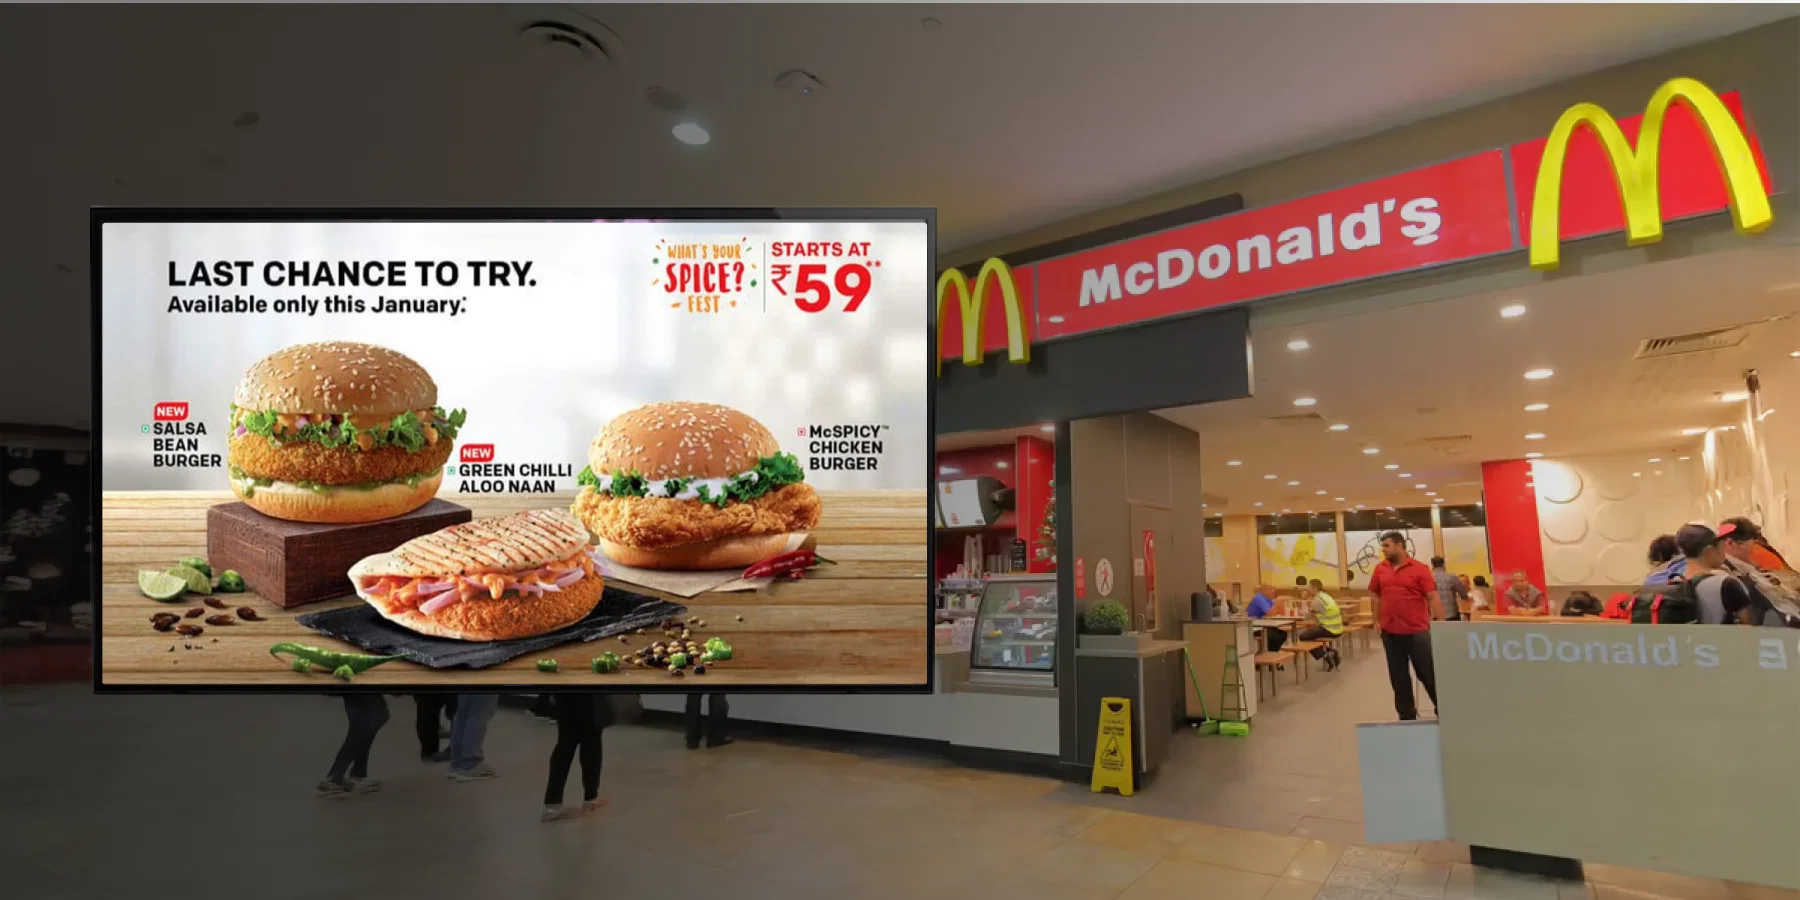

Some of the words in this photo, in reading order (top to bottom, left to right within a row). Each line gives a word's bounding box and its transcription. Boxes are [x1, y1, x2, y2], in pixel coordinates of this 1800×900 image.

[667, 243, 709, 260] WHAT'S
[711, 243, 742, 260] YOUR
[771, 241, 844, 257] STARTS
[847, 241, 871, 257] AT
[168, 260, 254, 287] LAST
[263, 260, 407, 287] CHANCE
[414, 260, 459, 287] TO
[466, 260, 537, 287] TRY.
[664, 261, 746, 294] SPICE?
[167, 295, 268, 313] Available
[273, 295, 319, 317] only
[324, 295, 366, 313] this
[687, 295, 721, 314] FEST
[157, 406, 186, 416] NEW
[153, 422, 207, 436] SALSA
[153, 438, 199, 452] BEAN
[809, 440, 883, 454] CHICKEN
[462, 448, 492, 459] NEW
[153, 454, 222, 468] BURGER
[809, 456, 878, 470] BURGER
[459, 463, 515, 477] GREEN
[519, 463, 572, 477] CHILLI
[458, 480, 505, 493] ALOO
[508, 480, 556, 493] NAAN
[1467, 631, 1720, 667] McDonald's
